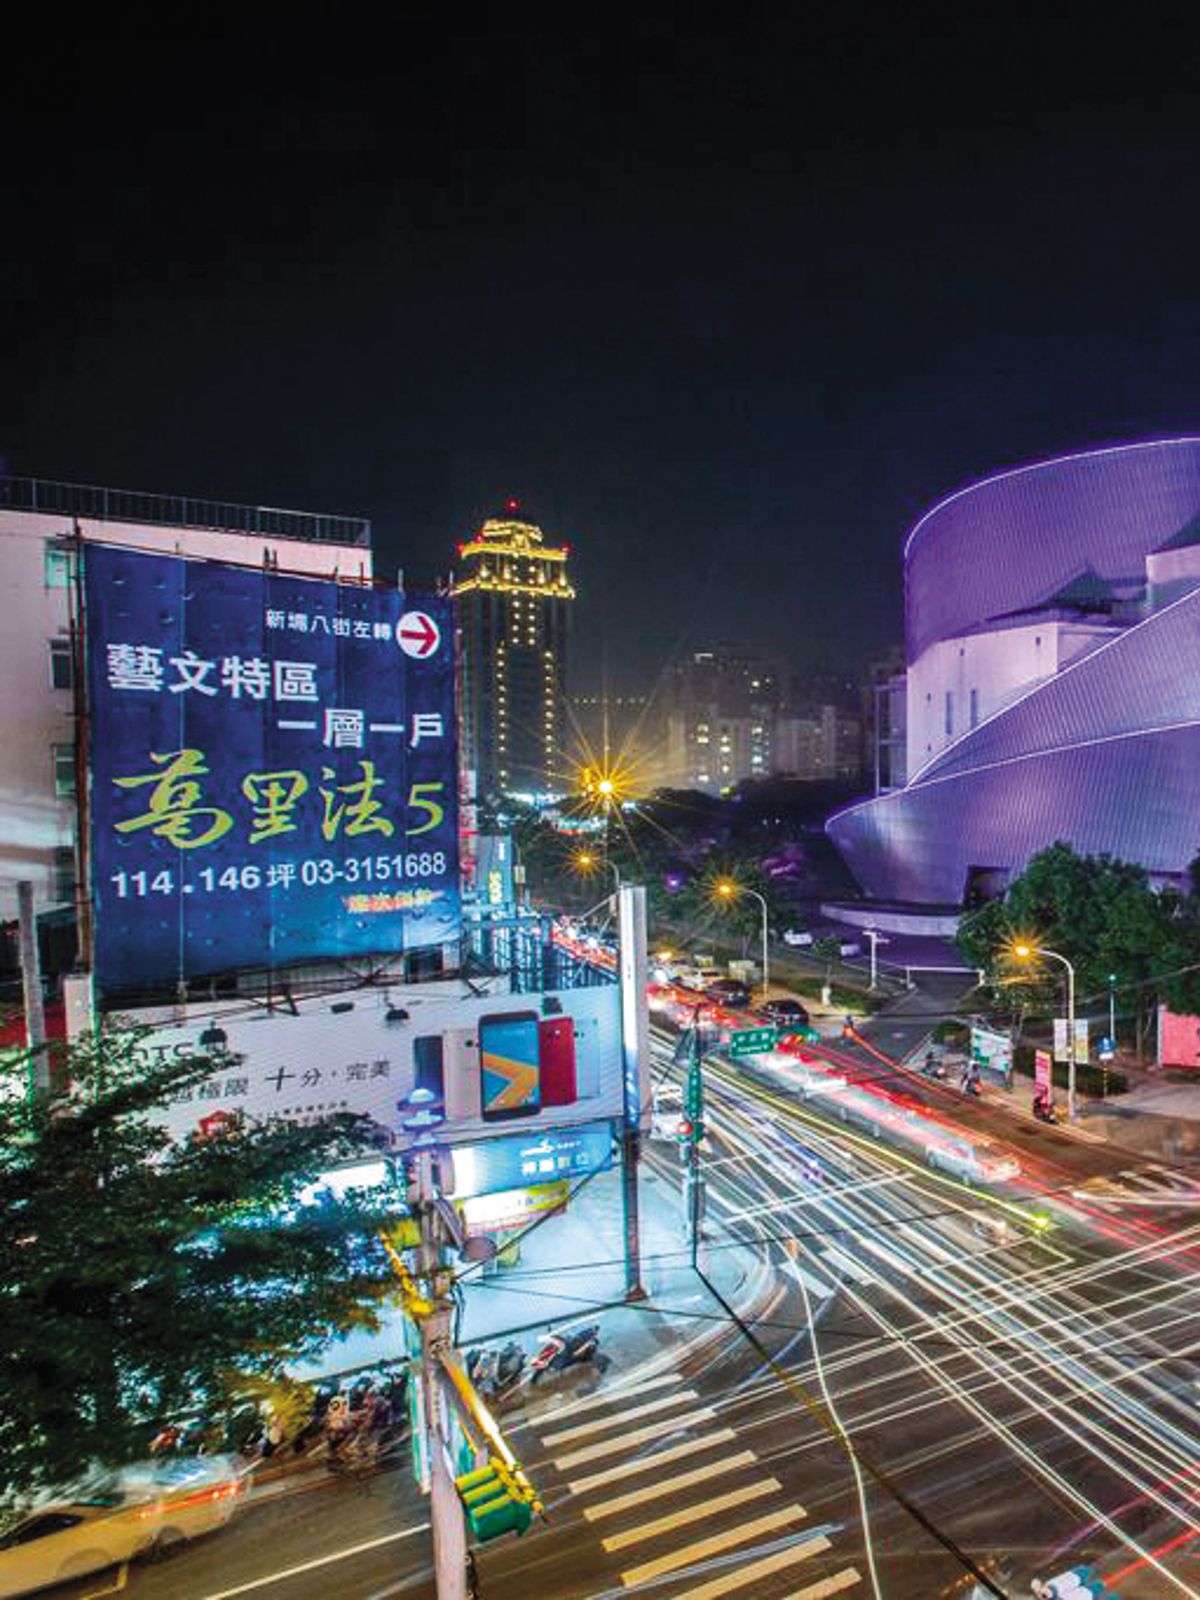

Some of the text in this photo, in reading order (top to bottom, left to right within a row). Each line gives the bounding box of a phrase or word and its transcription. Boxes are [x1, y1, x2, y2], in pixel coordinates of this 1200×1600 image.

[106, 643, 319, 702] 藝文特區
[302, 851, 446, 886] 03-3151688
